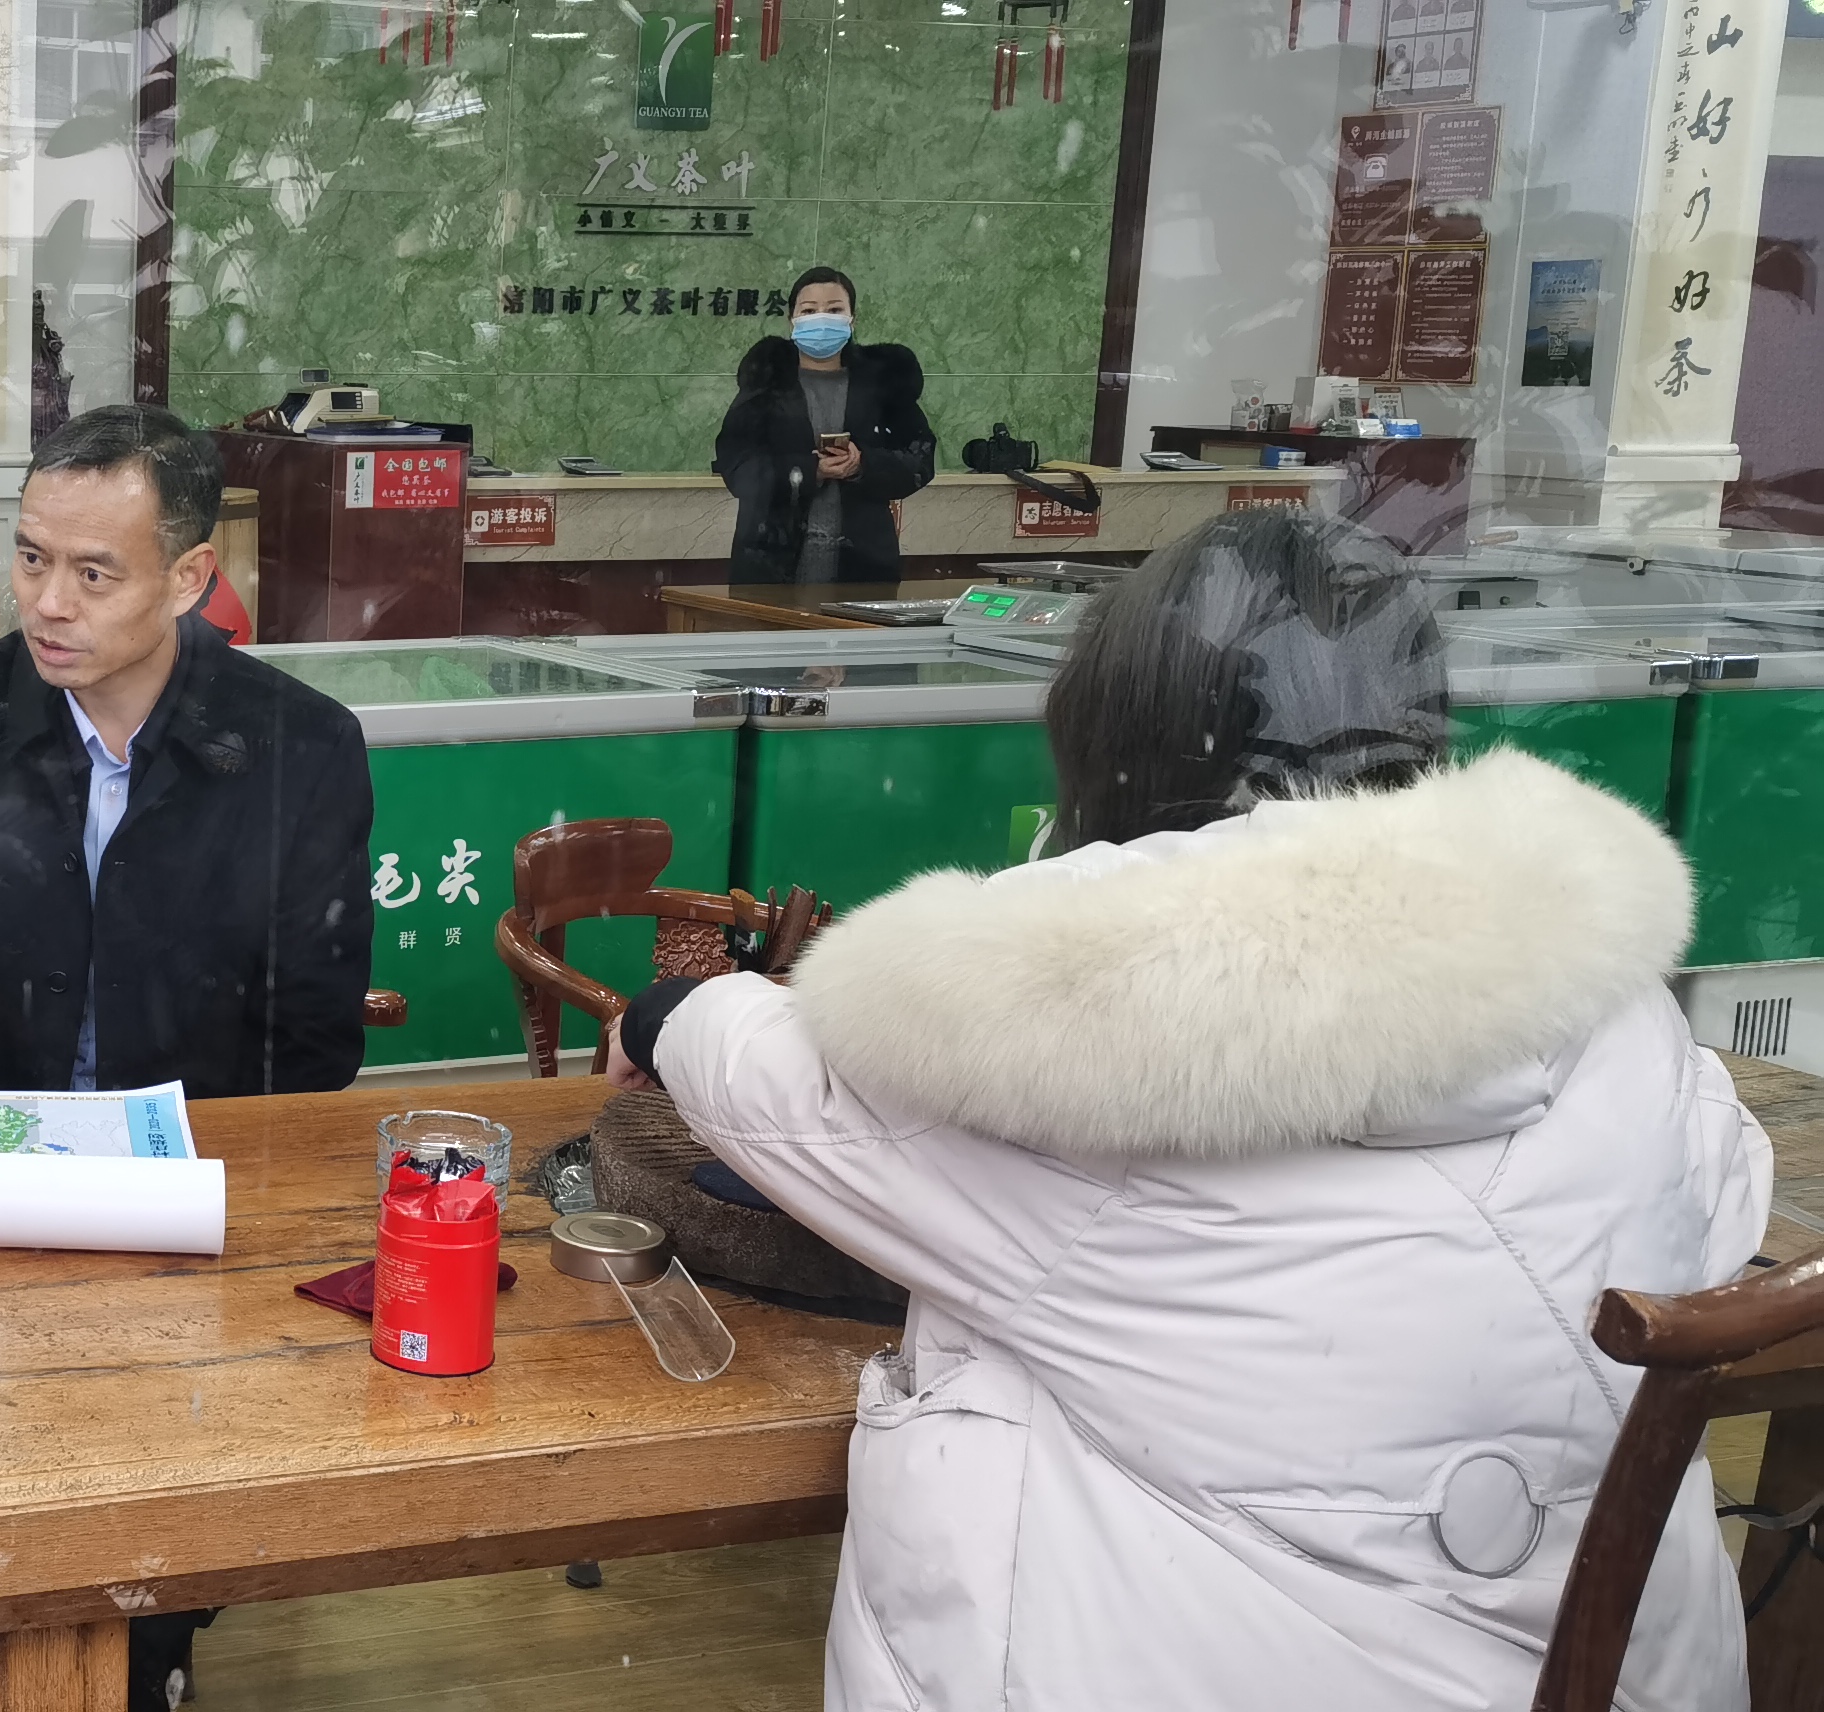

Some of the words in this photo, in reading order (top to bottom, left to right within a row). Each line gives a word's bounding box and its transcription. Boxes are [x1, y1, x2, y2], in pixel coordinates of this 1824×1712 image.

[638, 106, 686, 119] GUANGYI
[689, 106, 709, 119] TEA
[582, 136, 755, 198] 广义茶叶
[383, 456, 447, 473] 全国包邮
[490, 507, 548, 525] 游客投诉
[370, 838, 483, 910] 毛尖
[398, 926, 463, 950] 群贤
